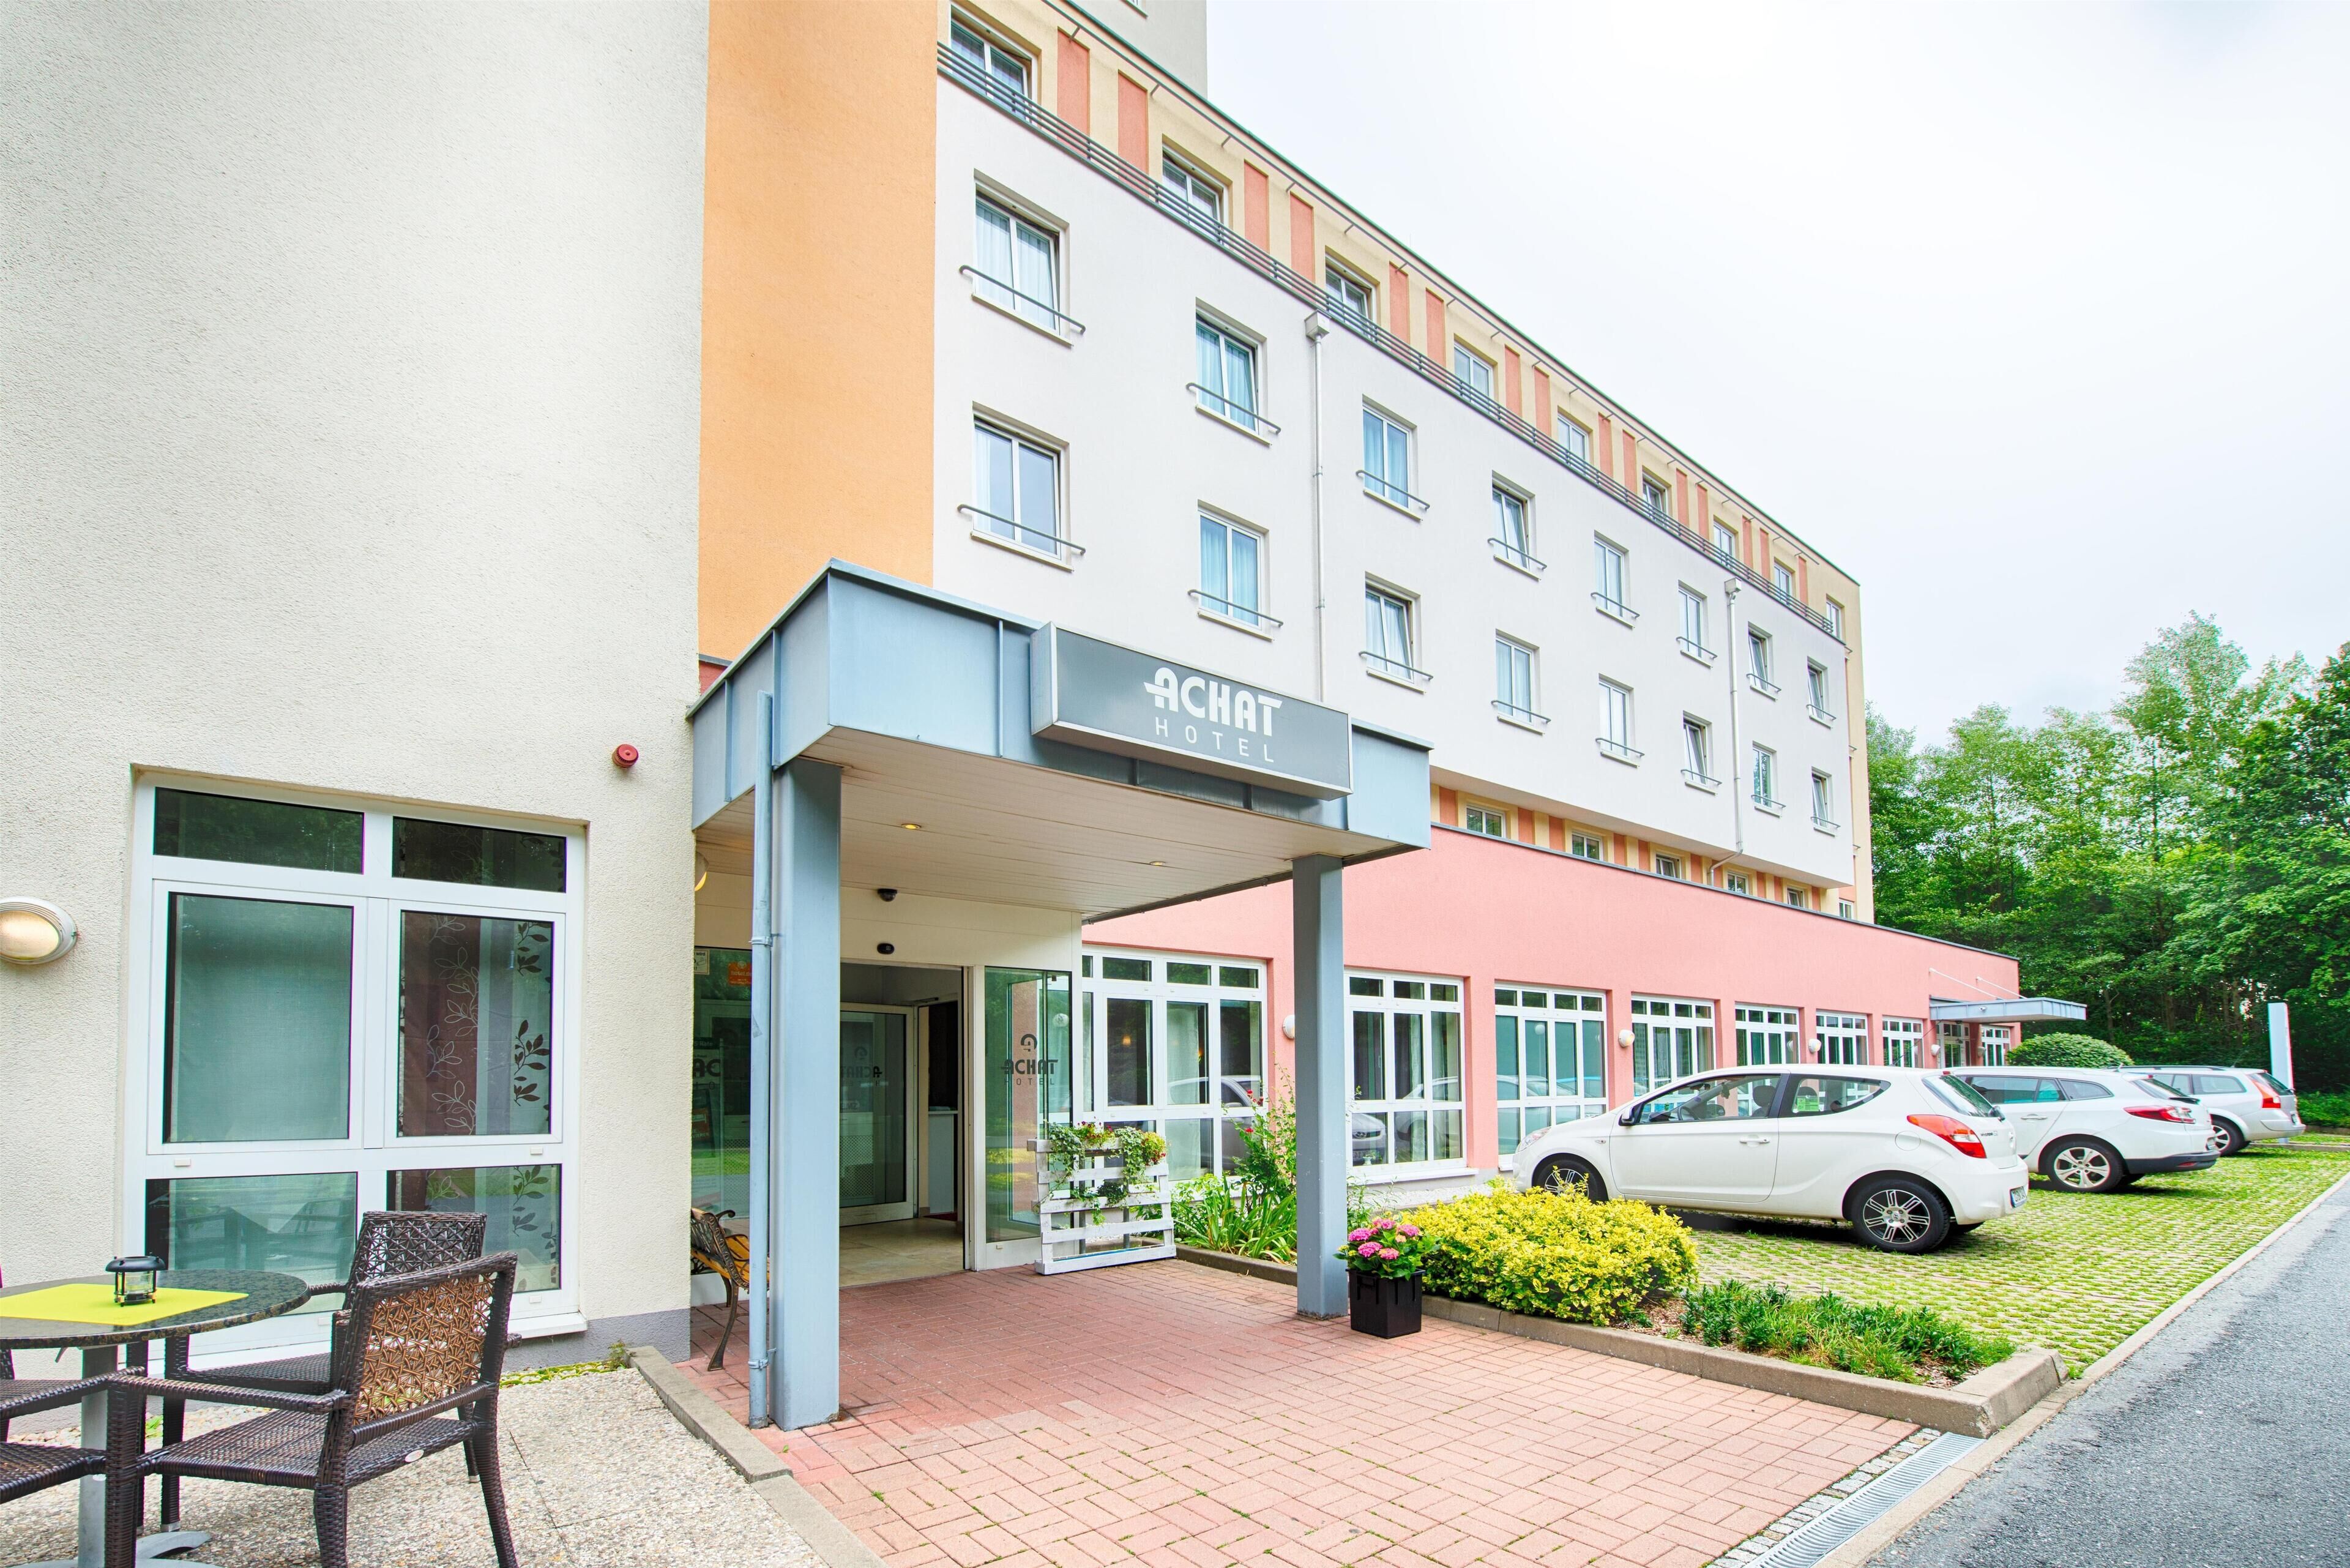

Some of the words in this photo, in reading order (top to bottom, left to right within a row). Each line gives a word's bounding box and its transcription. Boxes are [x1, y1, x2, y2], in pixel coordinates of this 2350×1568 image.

[1143, 666, 1283, 737] ACHAT
[1155, 716, 1274, 763] HOTEL
[1000, 1059, 1059, 1075] ACHAT
